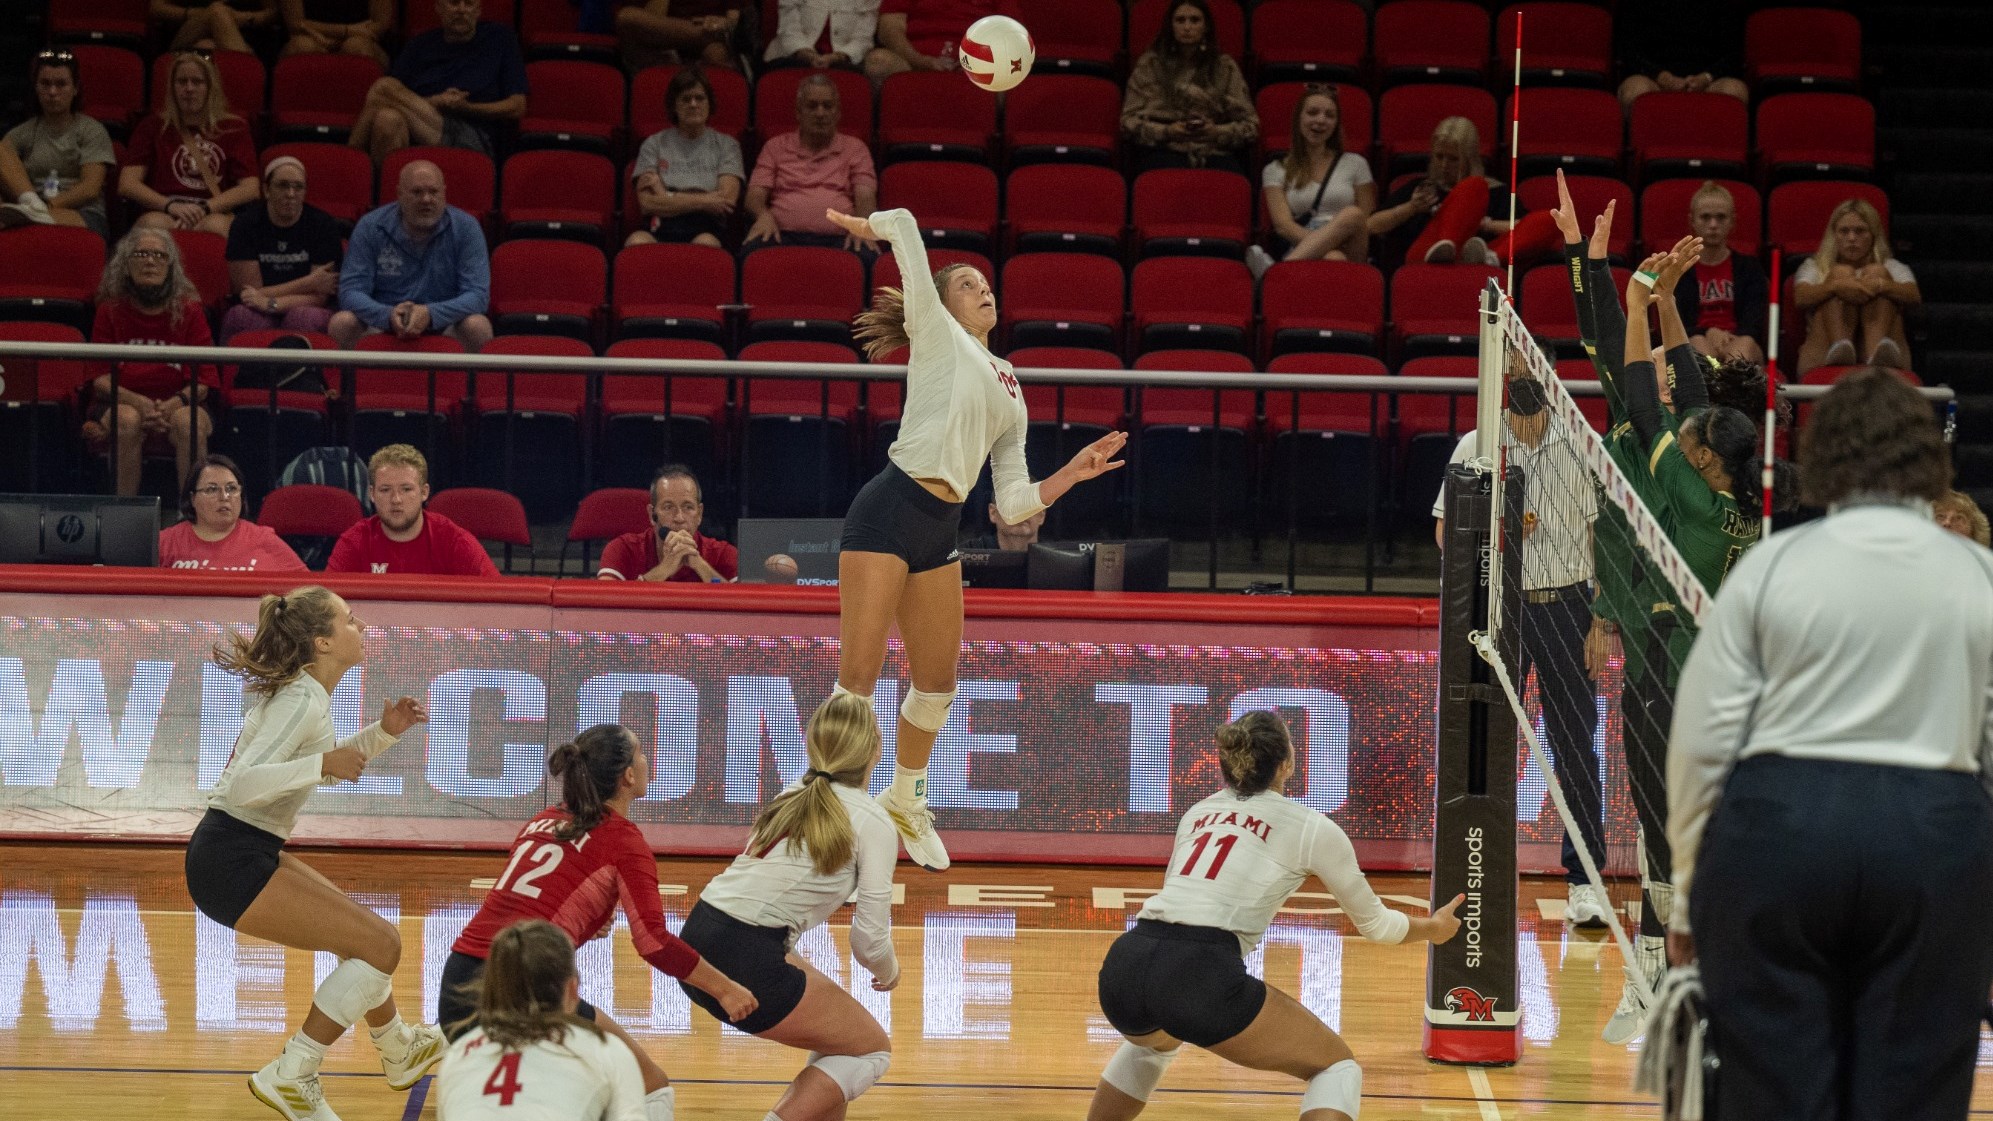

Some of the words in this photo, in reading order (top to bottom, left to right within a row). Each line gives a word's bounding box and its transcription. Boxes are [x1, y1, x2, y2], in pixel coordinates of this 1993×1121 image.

[1571, 256, 1584, 293] WRIGHT
[797, 578, 840, 587] DVSPOR
[1095, 682, 1349, 814] TO
[1190, 811, 1273, 844] MIAMI
[494, 839, 565, 900] 12
[1179, 831, 1239, 881] 11
[1465, 826, 1483, 889] sports
[1465, 892, 1482, 968] imports
[482, 1052, 524, 1107] 4
